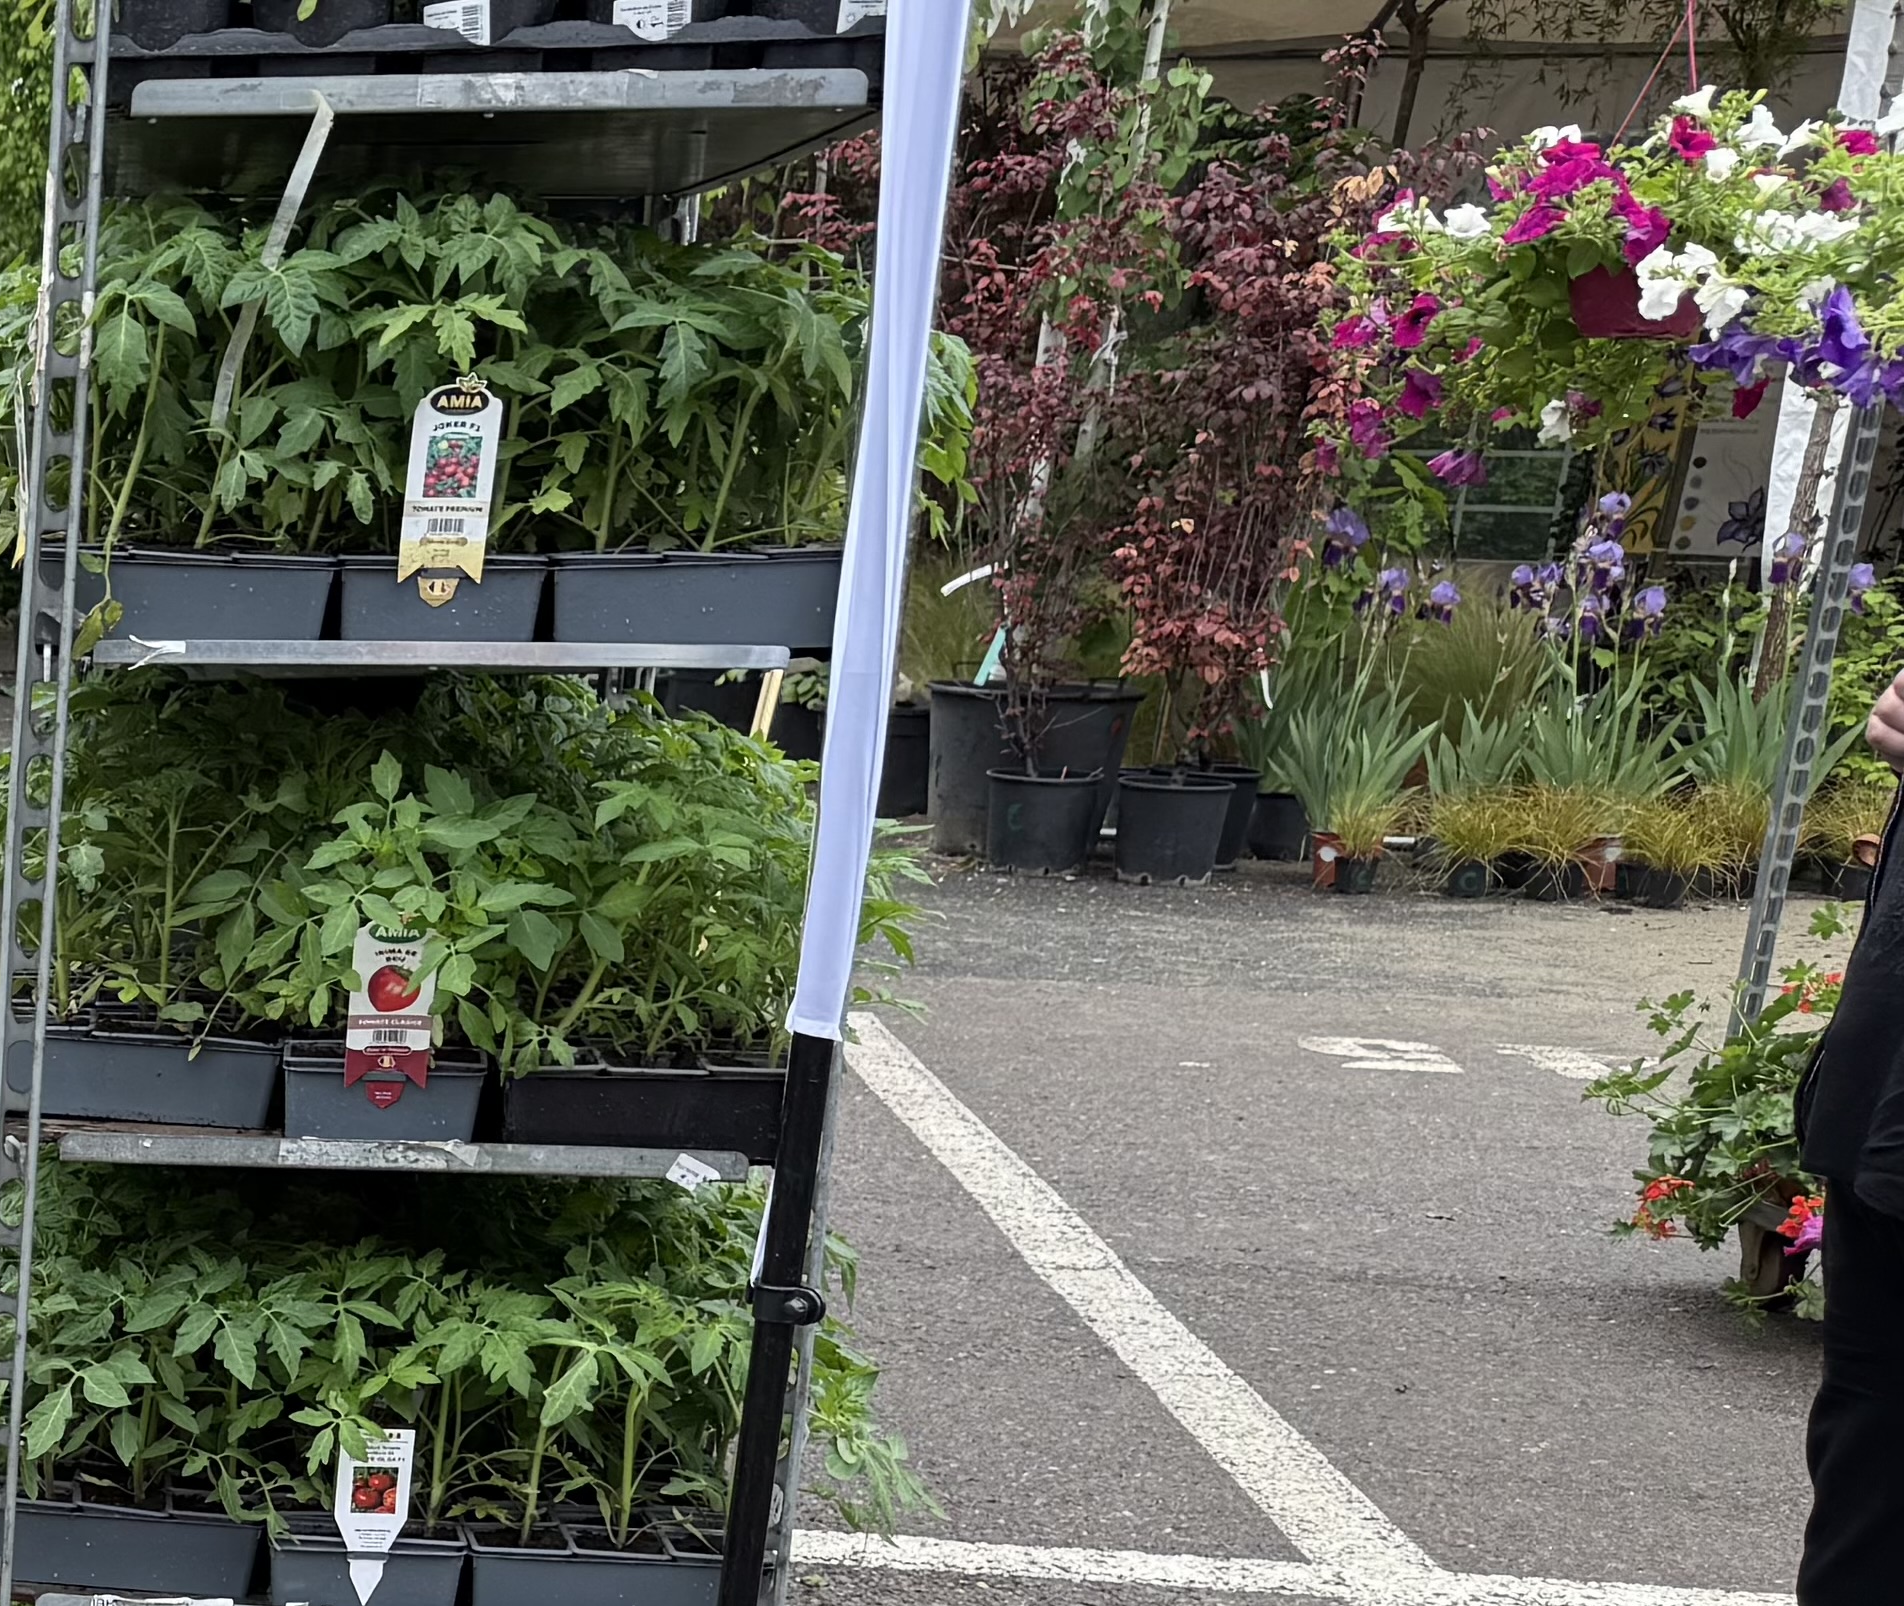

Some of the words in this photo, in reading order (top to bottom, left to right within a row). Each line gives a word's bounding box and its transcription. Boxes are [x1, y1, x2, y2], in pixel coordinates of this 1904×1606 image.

[437, 395, 482, 409] AMIA
[433, 421, 467, 432] JOKER
[375, 926, 420, 938] AMIA
